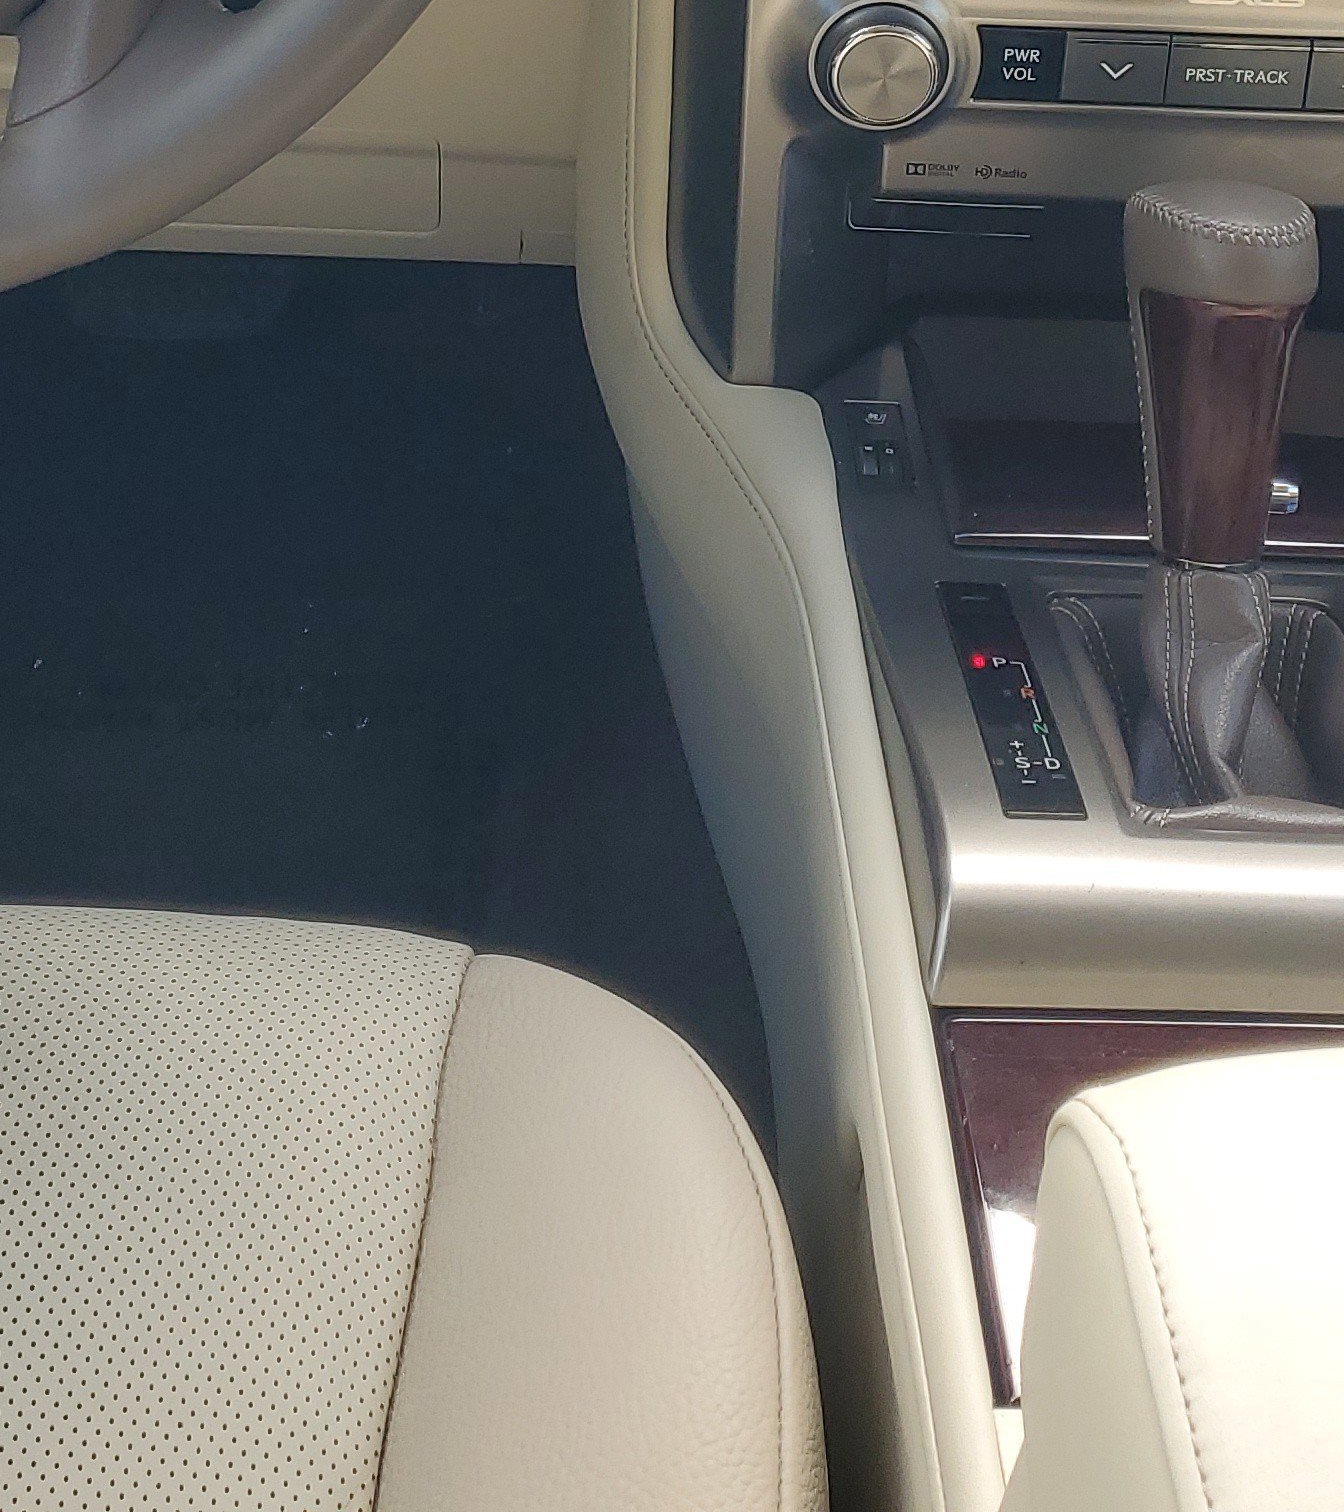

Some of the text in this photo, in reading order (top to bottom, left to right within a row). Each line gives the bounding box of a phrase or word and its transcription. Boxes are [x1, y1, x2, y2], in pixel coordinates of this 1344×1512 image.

[1003, 48, 1041, 63] PWR
[1002, 66, 1037, 82] VOL
[994, 168, 1028, 179] Radio
[992, 656, 1007, 669] P
[1032, 722, 1049, 734] N
[1015, 756, 1061, 770] S D
